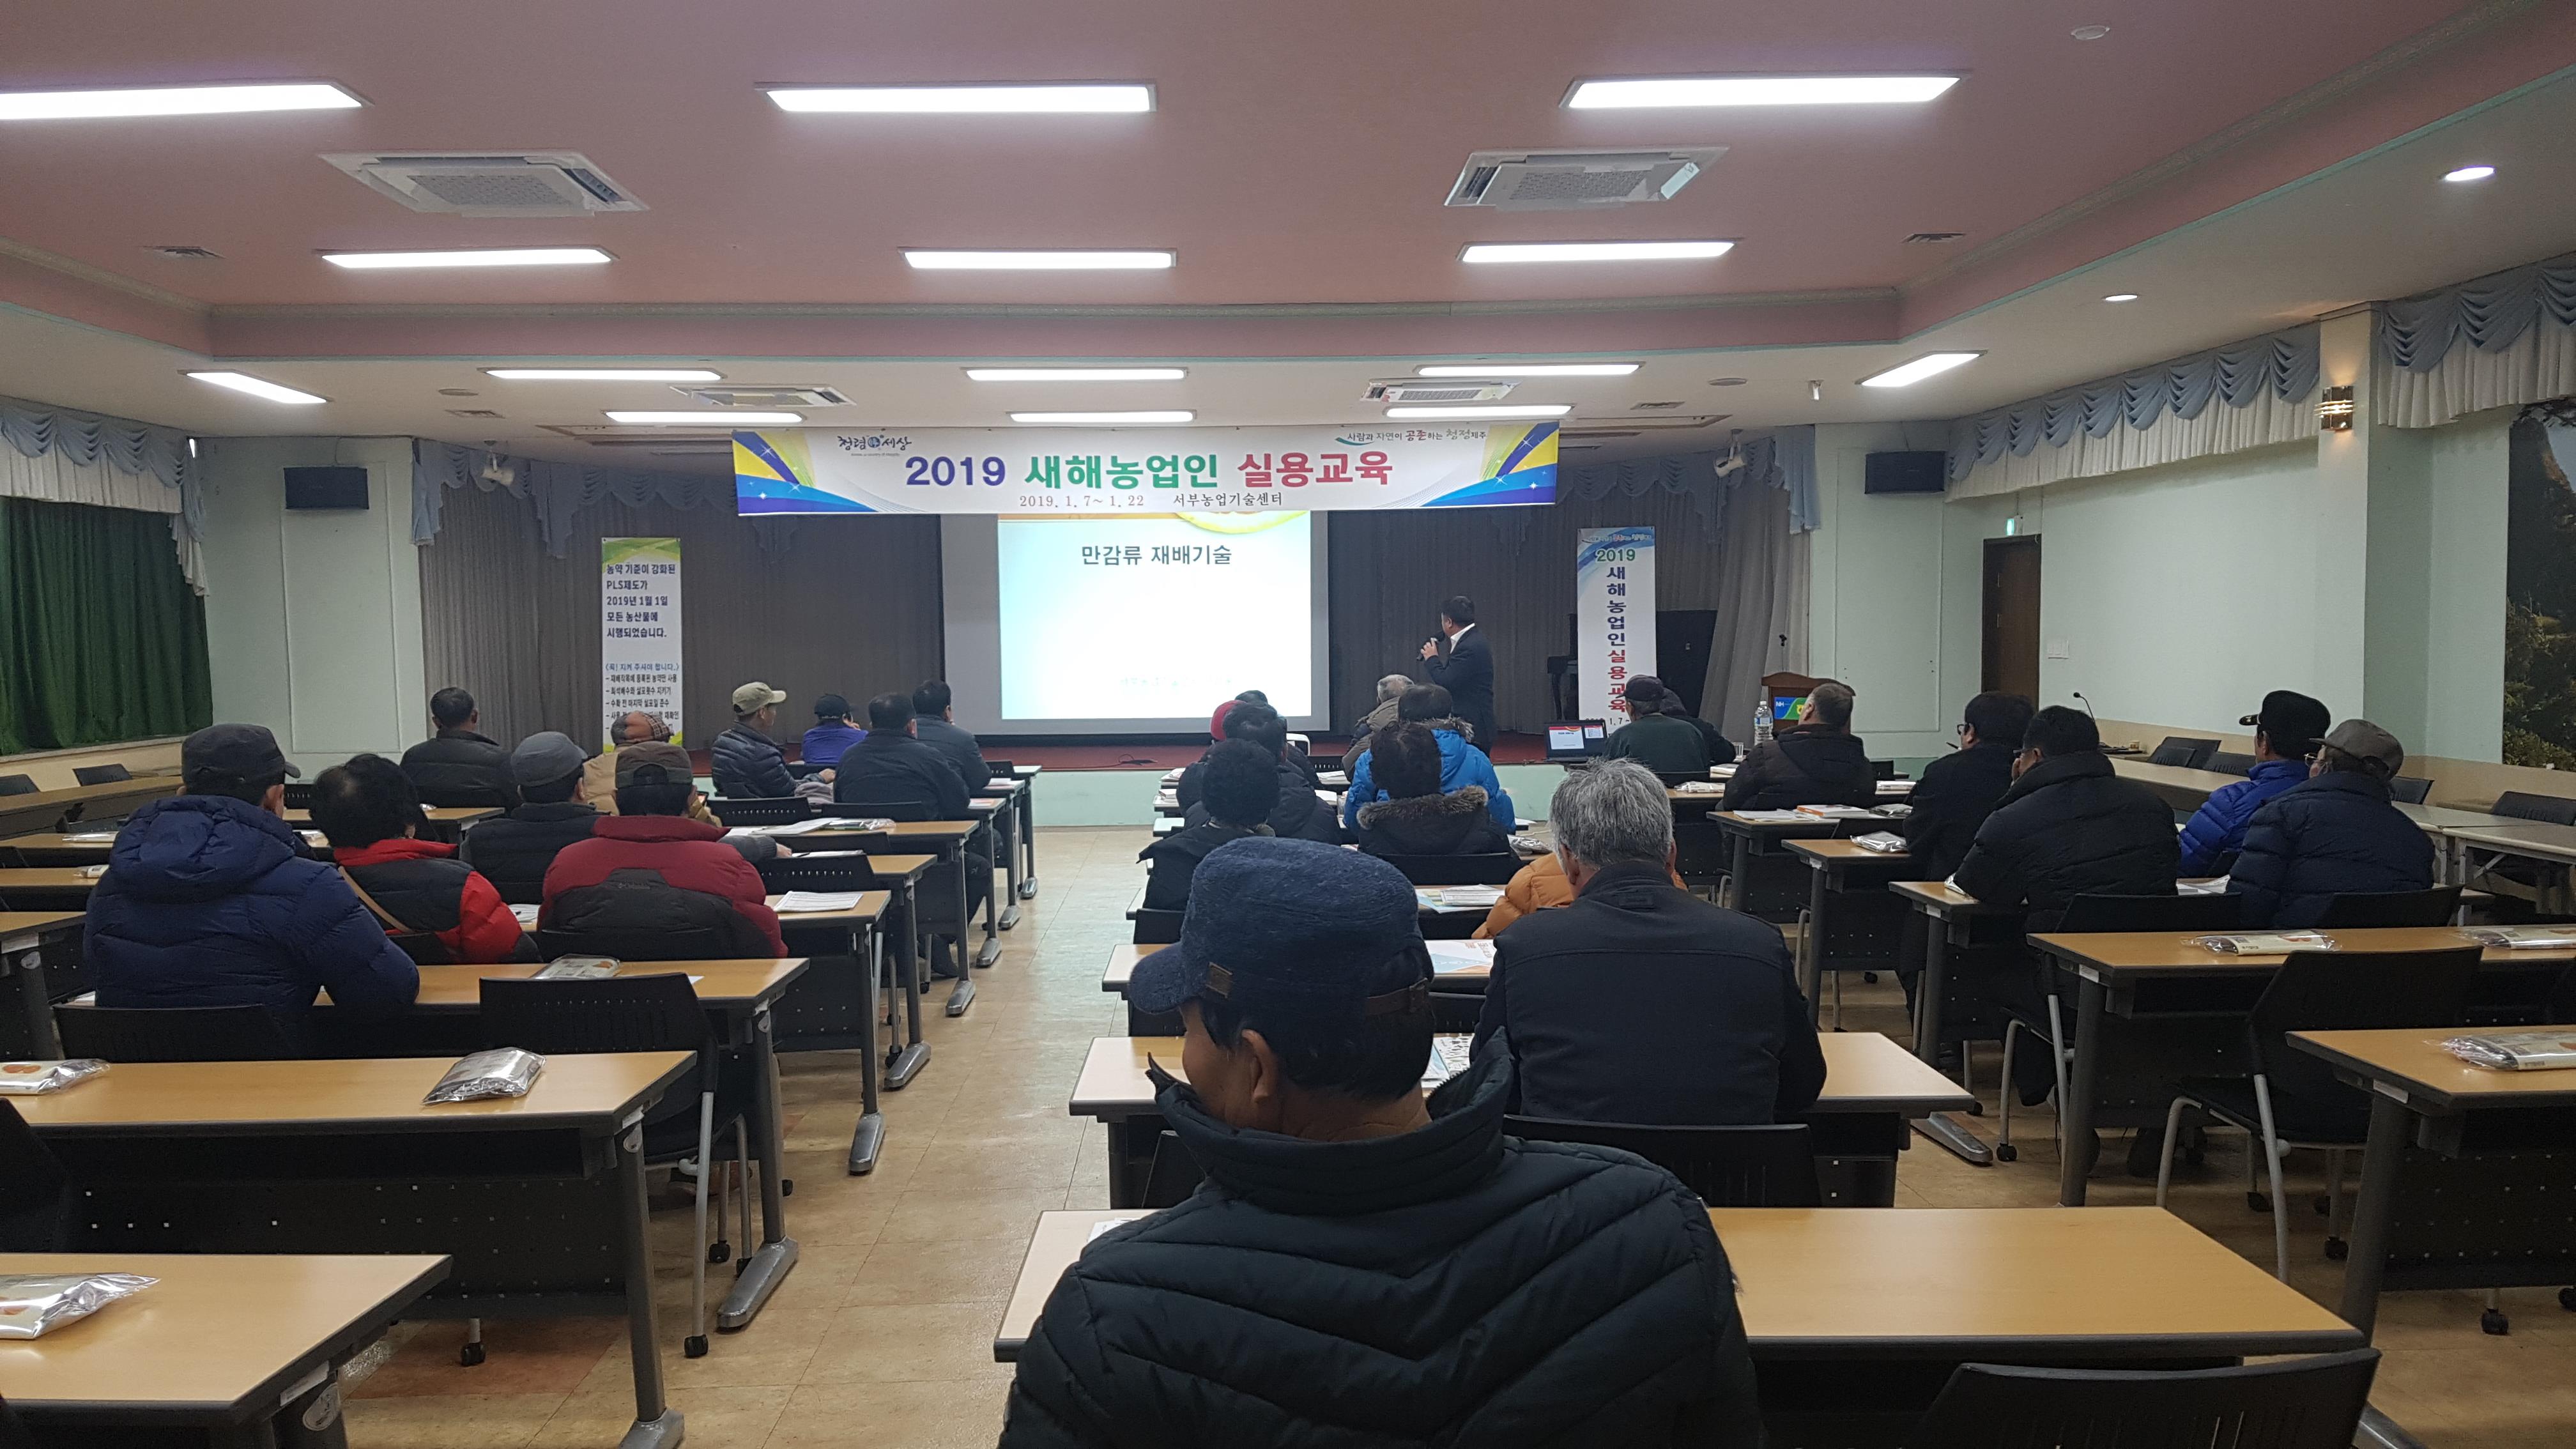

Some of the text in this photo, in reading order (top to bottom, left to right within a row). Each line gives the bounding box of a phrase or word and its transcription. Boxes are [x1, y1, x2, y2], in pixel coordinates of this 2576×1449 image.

[1347, 432, 1373, 441] 사람과
[1376, 433, 1402, 441] 자연이
[1405, 429, 1443, 441] 공존하는
[905, 450, 1393, 489] 2019 새해농업인 실용교육
[1128, 494, 1145, 507] 22
[1172, 491, 1283, 507] 서부농업기술센터
[1081, 545, 1232, 566] 만감류 재배기술
[1597, 548, 1636, 562] 2019
[606, 564, 675, 574] 농약 기준이 강화된
[606, 579, 648, 590] PLS제도가
[606, 595, 668, 606] 2019년 1월 1일
[606, 611, 658, 622] 모든 농산물에
[606, 627, 667, 638] 시행되었습니다.
